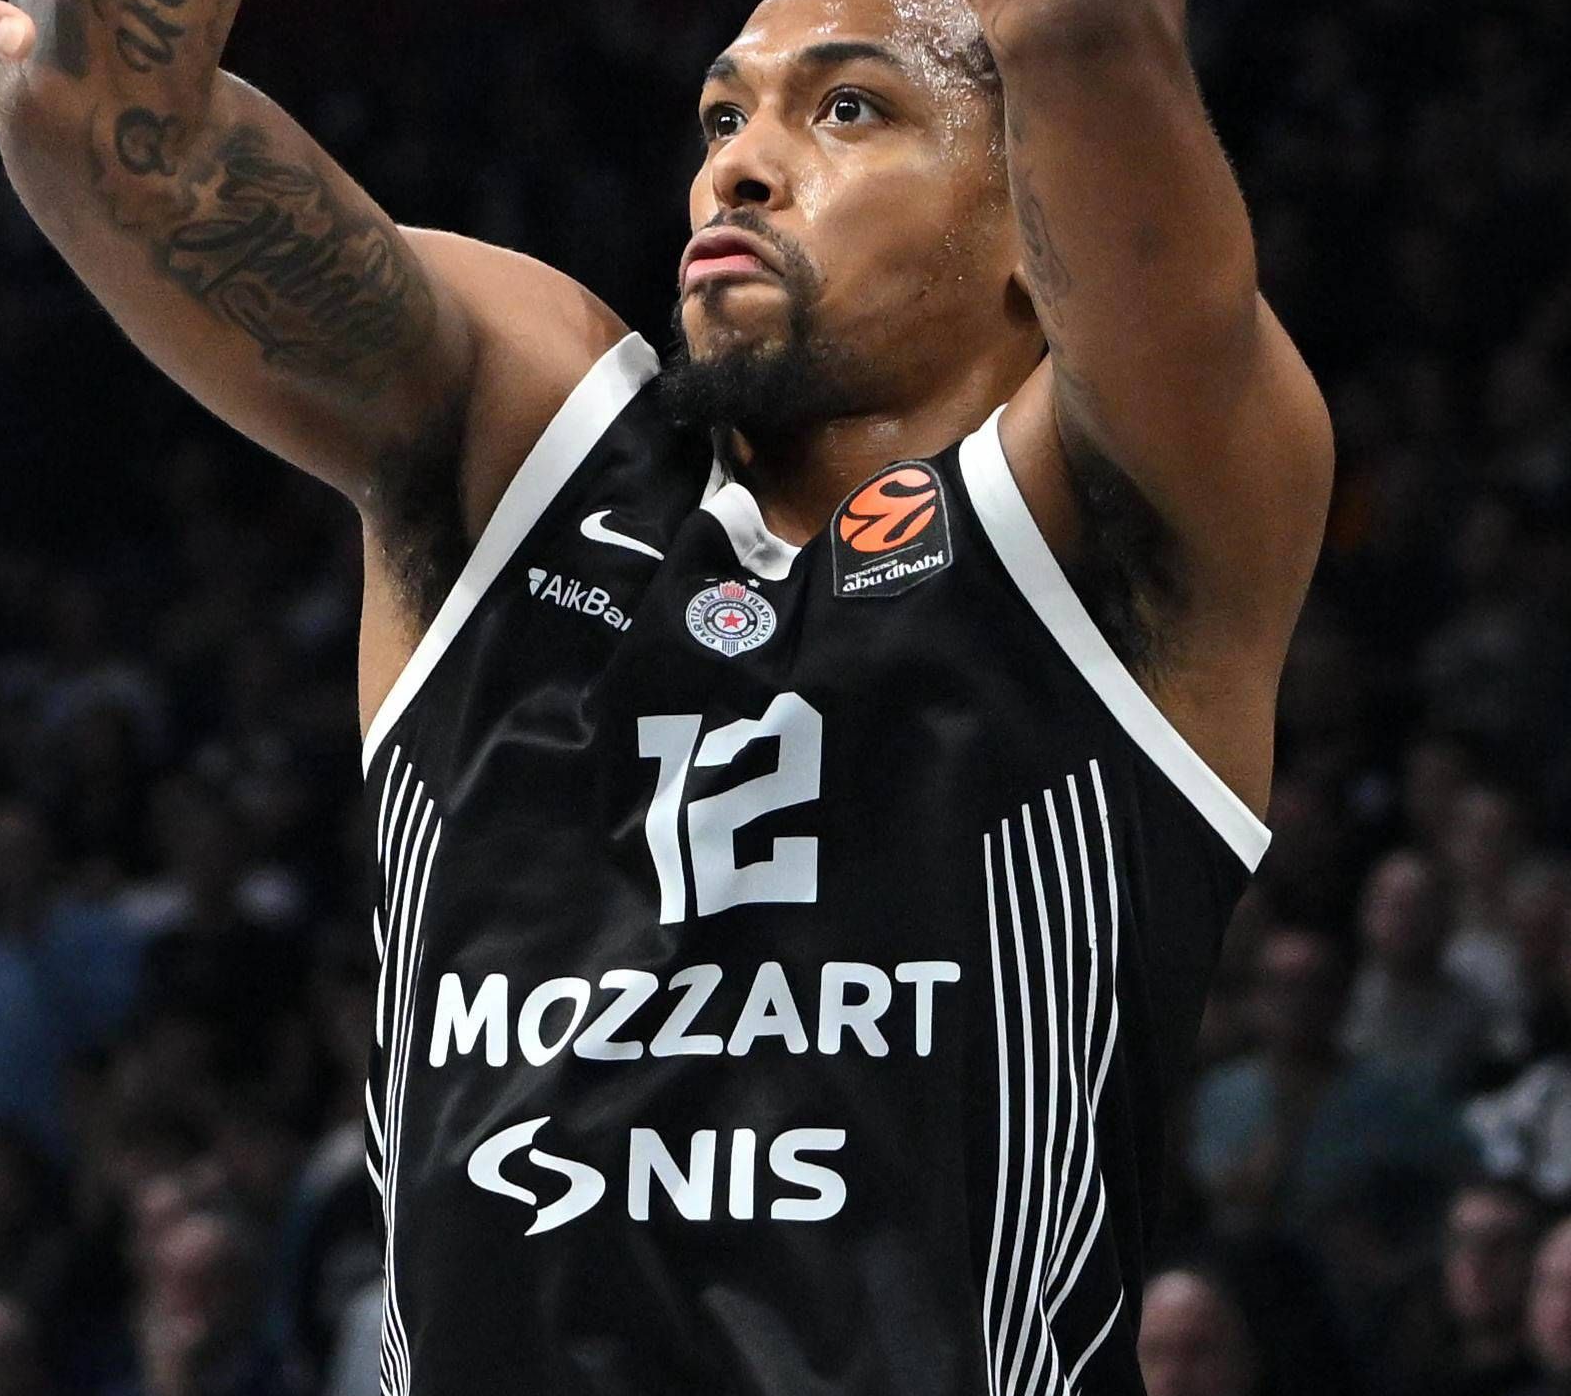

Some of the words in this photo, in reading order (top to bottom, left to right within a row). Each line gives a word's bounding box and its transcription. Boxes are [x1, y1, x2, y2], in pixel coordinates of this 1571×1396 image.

[842, 571, 882, 592] abu
[885, 550, 944, 581] dhabi
[637, 691, 823, 925] 12
[429, 961, 961, 1067] MOZZART
[627, 1127, 846, 1221] NIS
